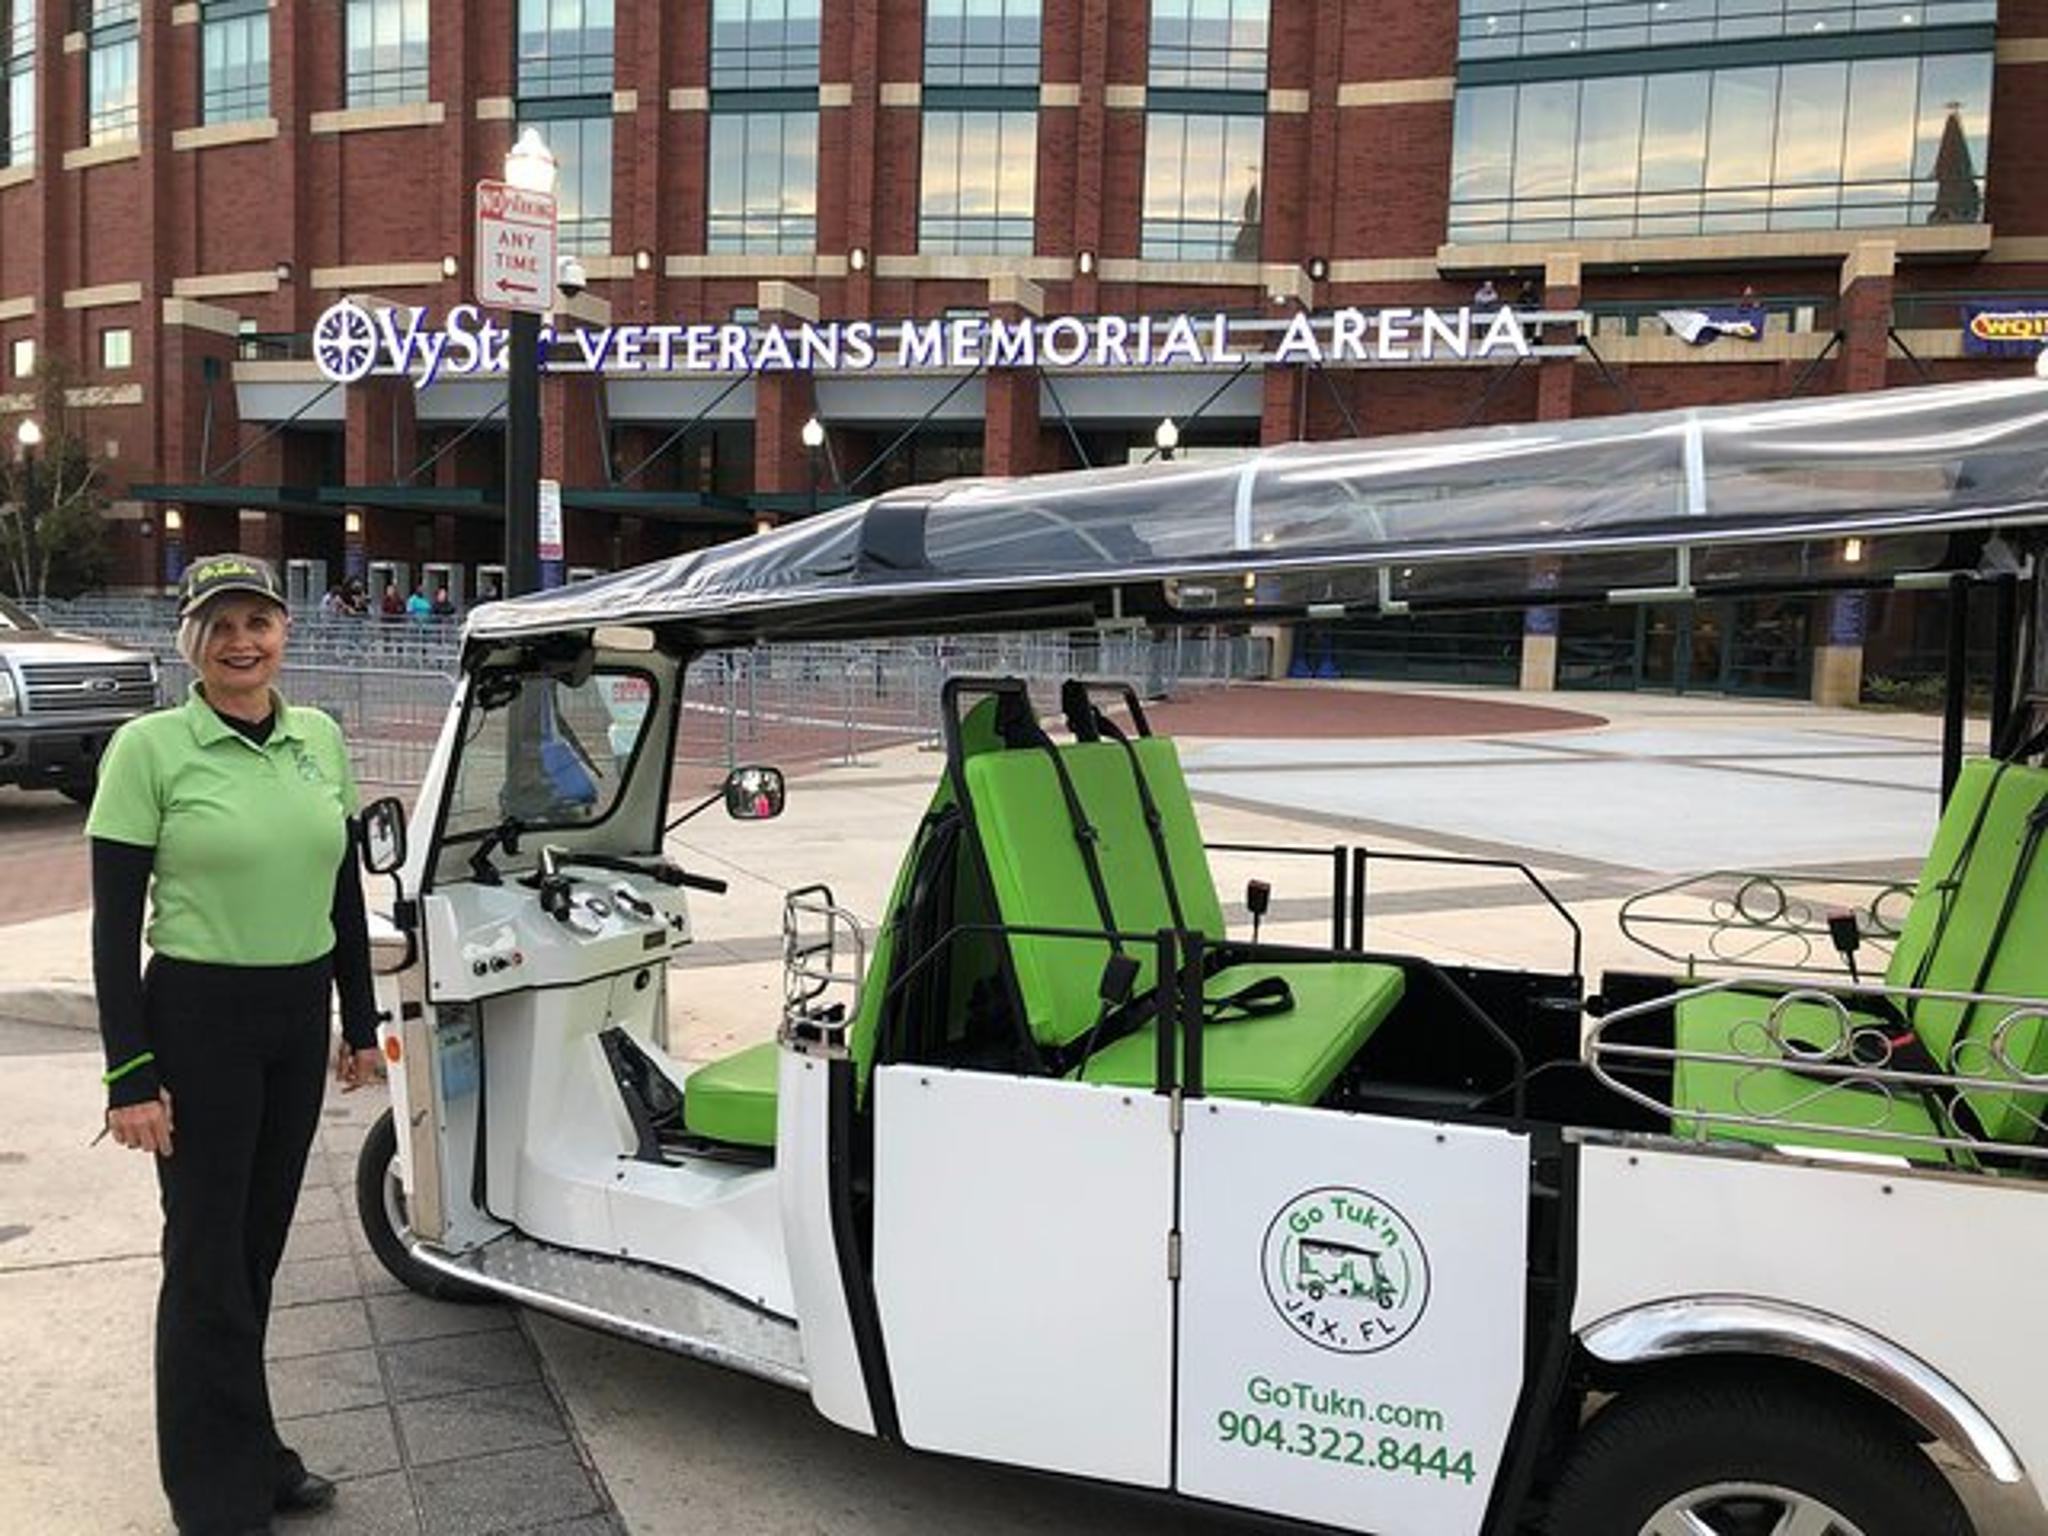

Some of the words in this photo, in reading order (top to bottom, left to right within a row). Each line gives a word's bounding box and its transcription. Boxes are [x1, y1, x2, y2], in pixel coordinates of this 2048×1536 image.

[496, 252, 538, 273] TIME
[498, 231, 535, 249] ANY
[575, 322, 878, 371] VETERANS
[898, 312, 1246, 368] MEMORIAL
[1274, 305, 1531, 361] ARENA
[1289, 1207, 1323, 1233] Go
[1331, 1197, 1399, 1247] Tuk'n
[1359, 1317, 1396, 1341] FL
[1247, 1376, 1443, 1432] GoTukn.com
[1217, 1410, 1477, 1486] 904.322.8444
